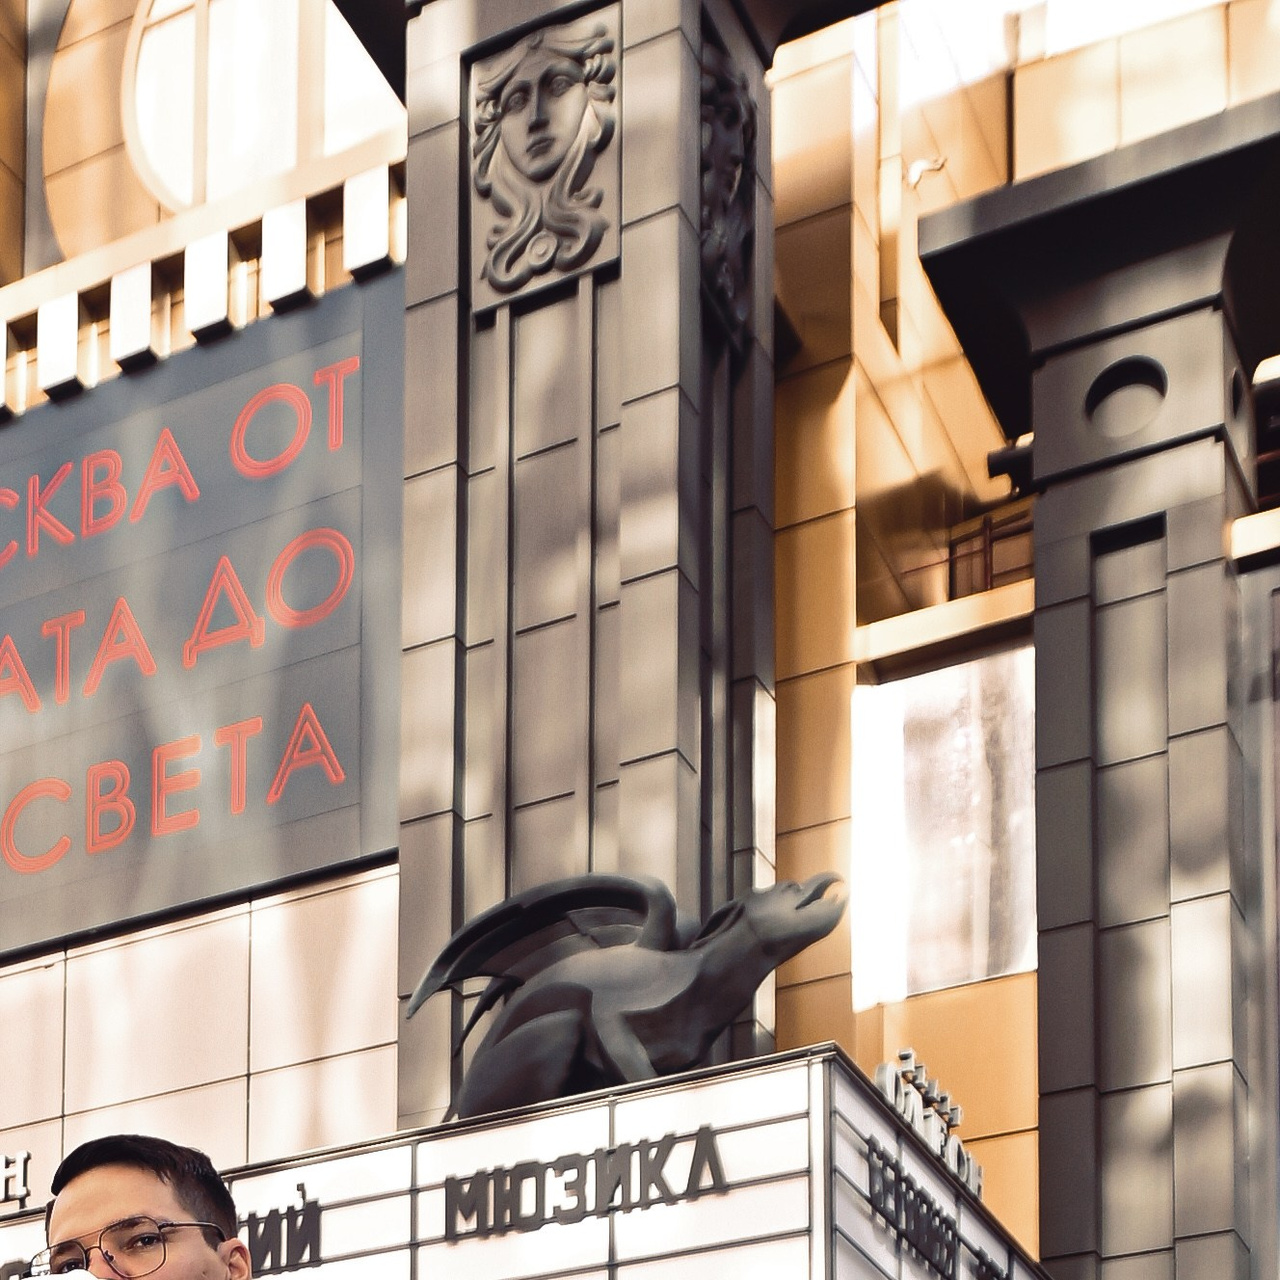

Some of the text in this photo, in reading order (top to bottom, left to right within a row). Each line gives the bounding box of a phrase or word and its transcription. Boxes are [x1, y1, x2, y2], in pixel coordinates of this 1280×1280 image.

[230, 355, 360, 479] ОТ
[183, 528, 355, 669] ДО
[445, 1123, 728, 1244] МЮЗИКЛ
